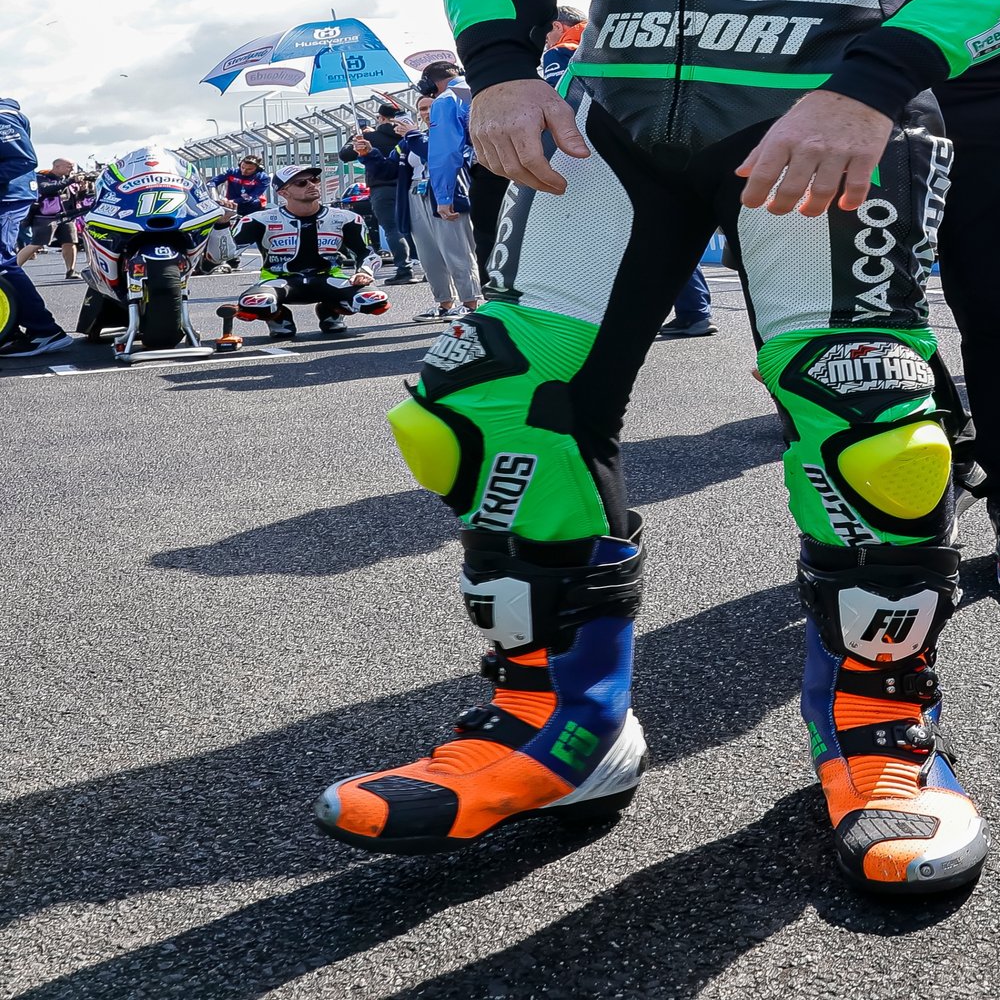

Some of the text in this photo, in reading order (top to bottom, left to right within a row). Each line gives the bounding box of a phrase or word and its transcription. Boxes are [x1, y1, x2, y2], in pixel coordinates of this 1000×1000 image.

[295, 35, 359, 48] Husqvarna
[594, 11, 823, 55] FüSPORT
[122, 172, 190, 191] sterilgarda
[136, 190, 188, 217] 17
[852, 198, 899, 322] YACCO
[828, 358, 928, 383] MITHOS
[860, 609, 919, 644] Fü
